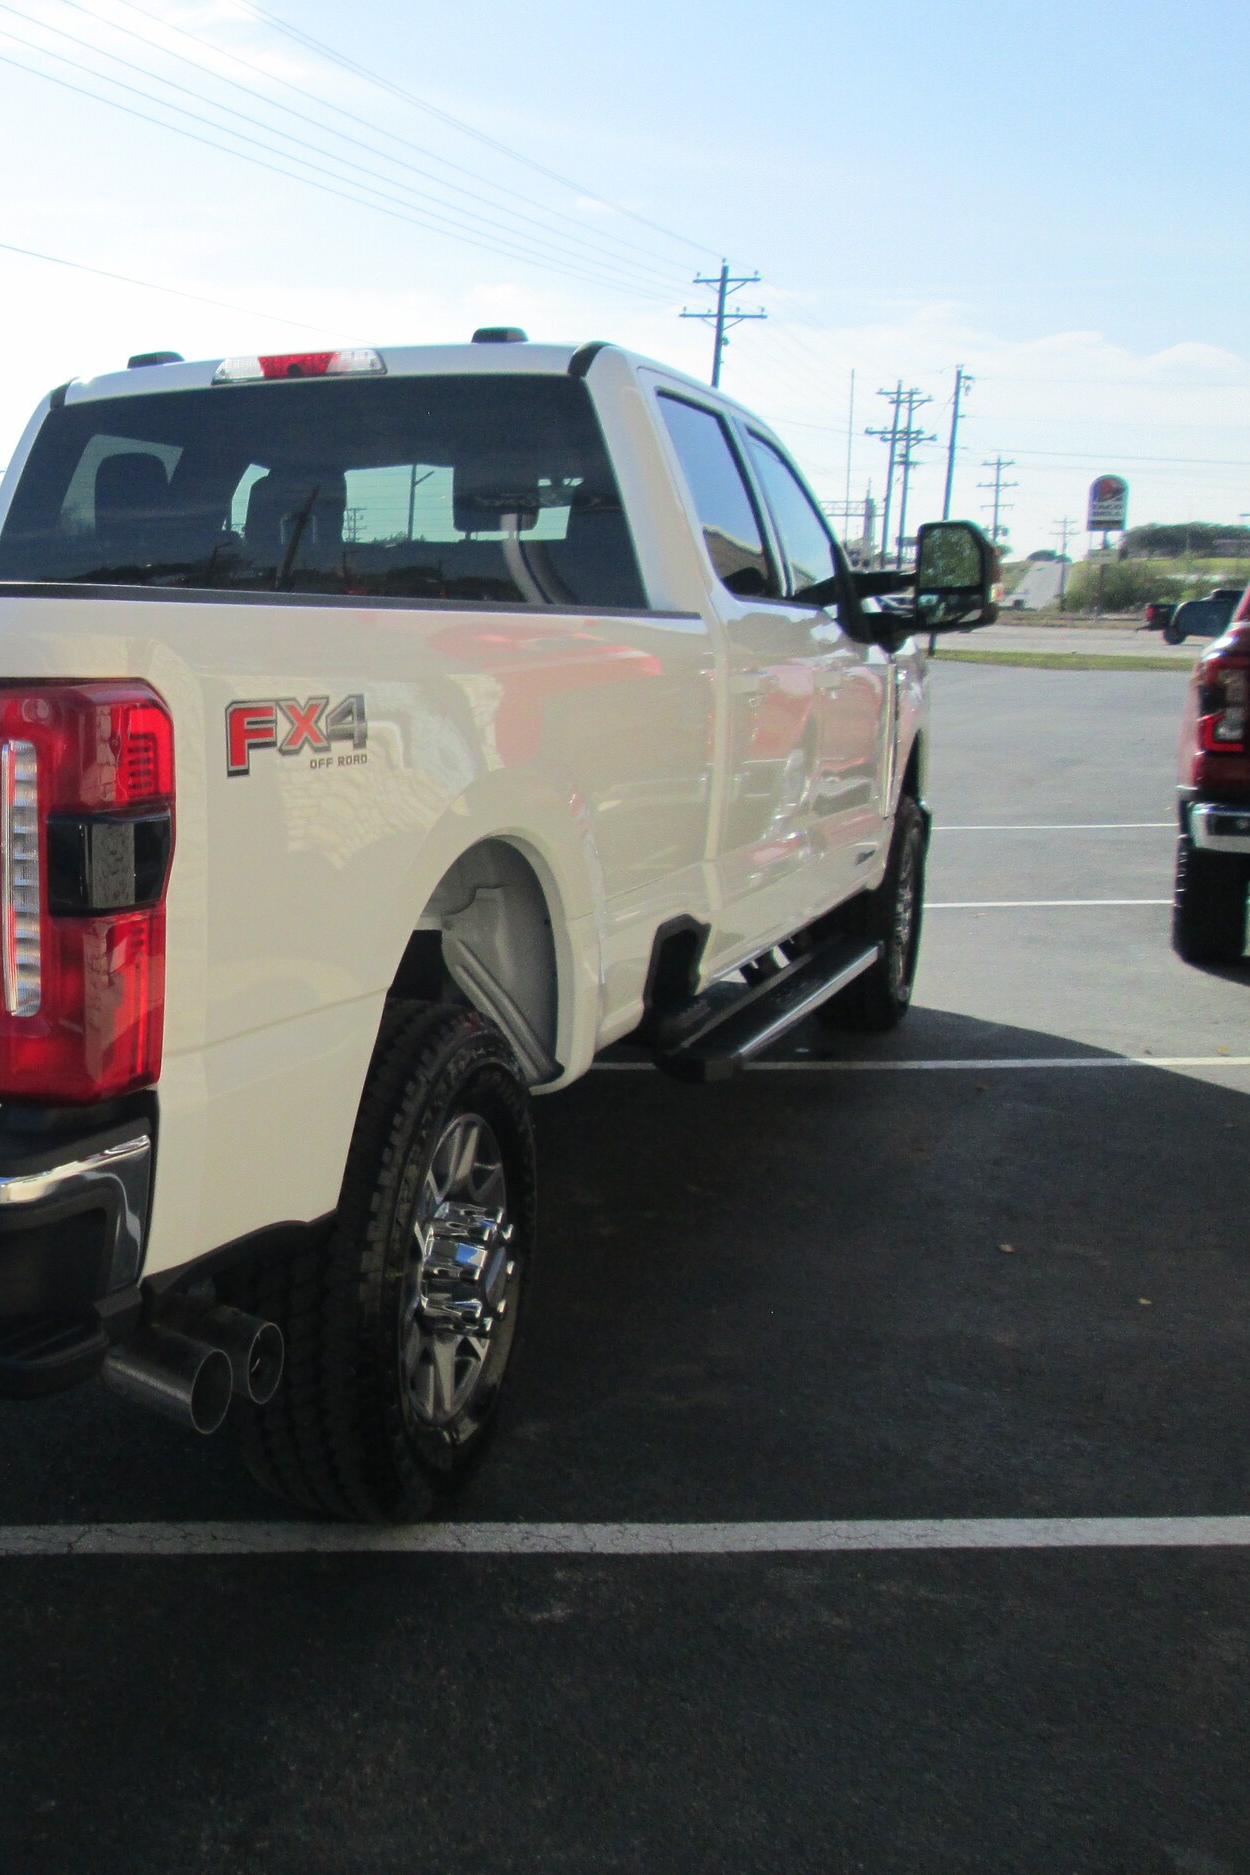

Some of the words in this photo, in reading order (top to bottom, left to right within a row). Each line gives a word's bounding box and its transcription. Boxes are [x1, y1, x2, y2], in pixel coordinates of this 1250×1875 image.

[225, 694, 367, 777] FX4
[310, 757, 334, 769] OFF
[338, 754, 367, 767] ROAD
